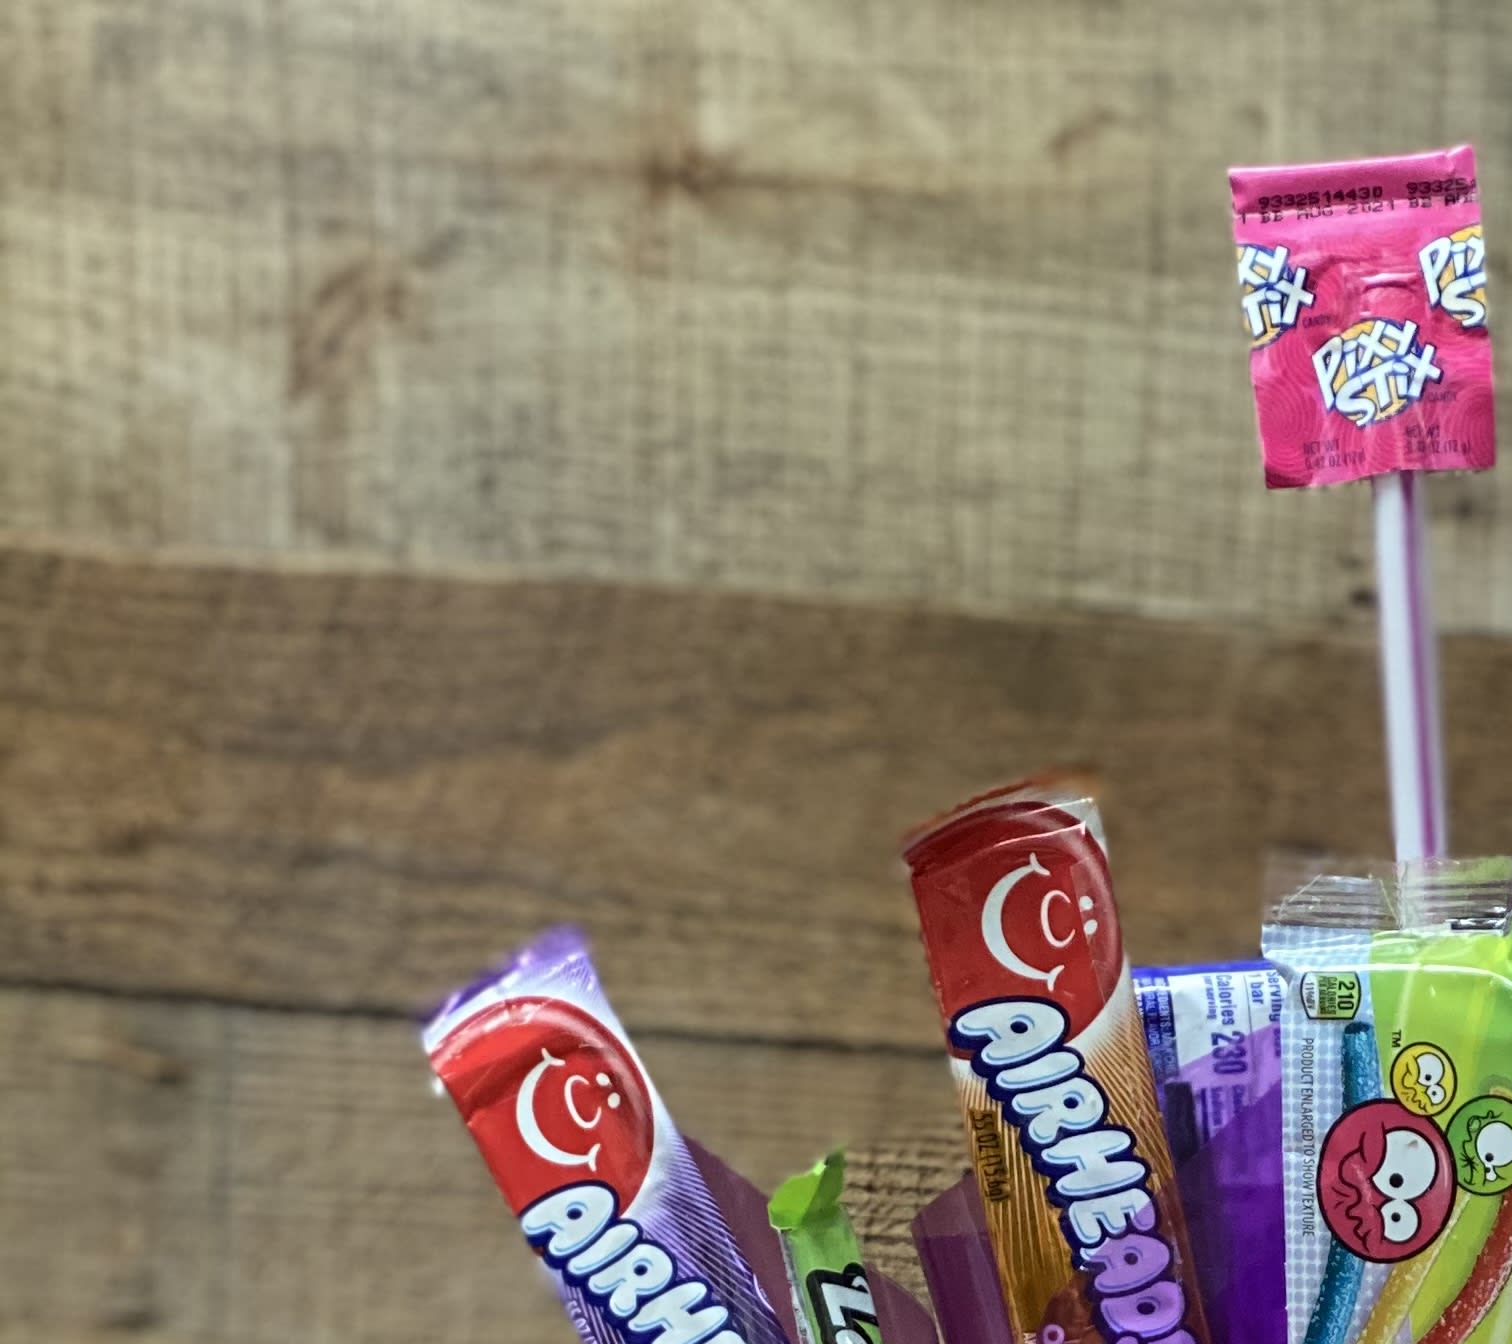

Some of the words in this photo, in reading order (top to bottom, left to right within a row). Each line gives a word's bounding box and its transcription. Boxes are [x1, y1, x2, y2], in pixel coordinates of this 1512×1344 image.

[1214, 974, 1235, 1027] Calories
[1337, 980, 1355, 1010] 210
[1210, 1030, 1248, 1076] 230
[1299, 1038, 1314, 1085] PRODUCT
[1300, 1088, 1315, 1141] ENLARGED
[1302, 1143, 1314, 1155] TO
[1301, 1158, 1315, 1191] SHOW
[1300, 1192, 1315, 1236] TEXTURE
